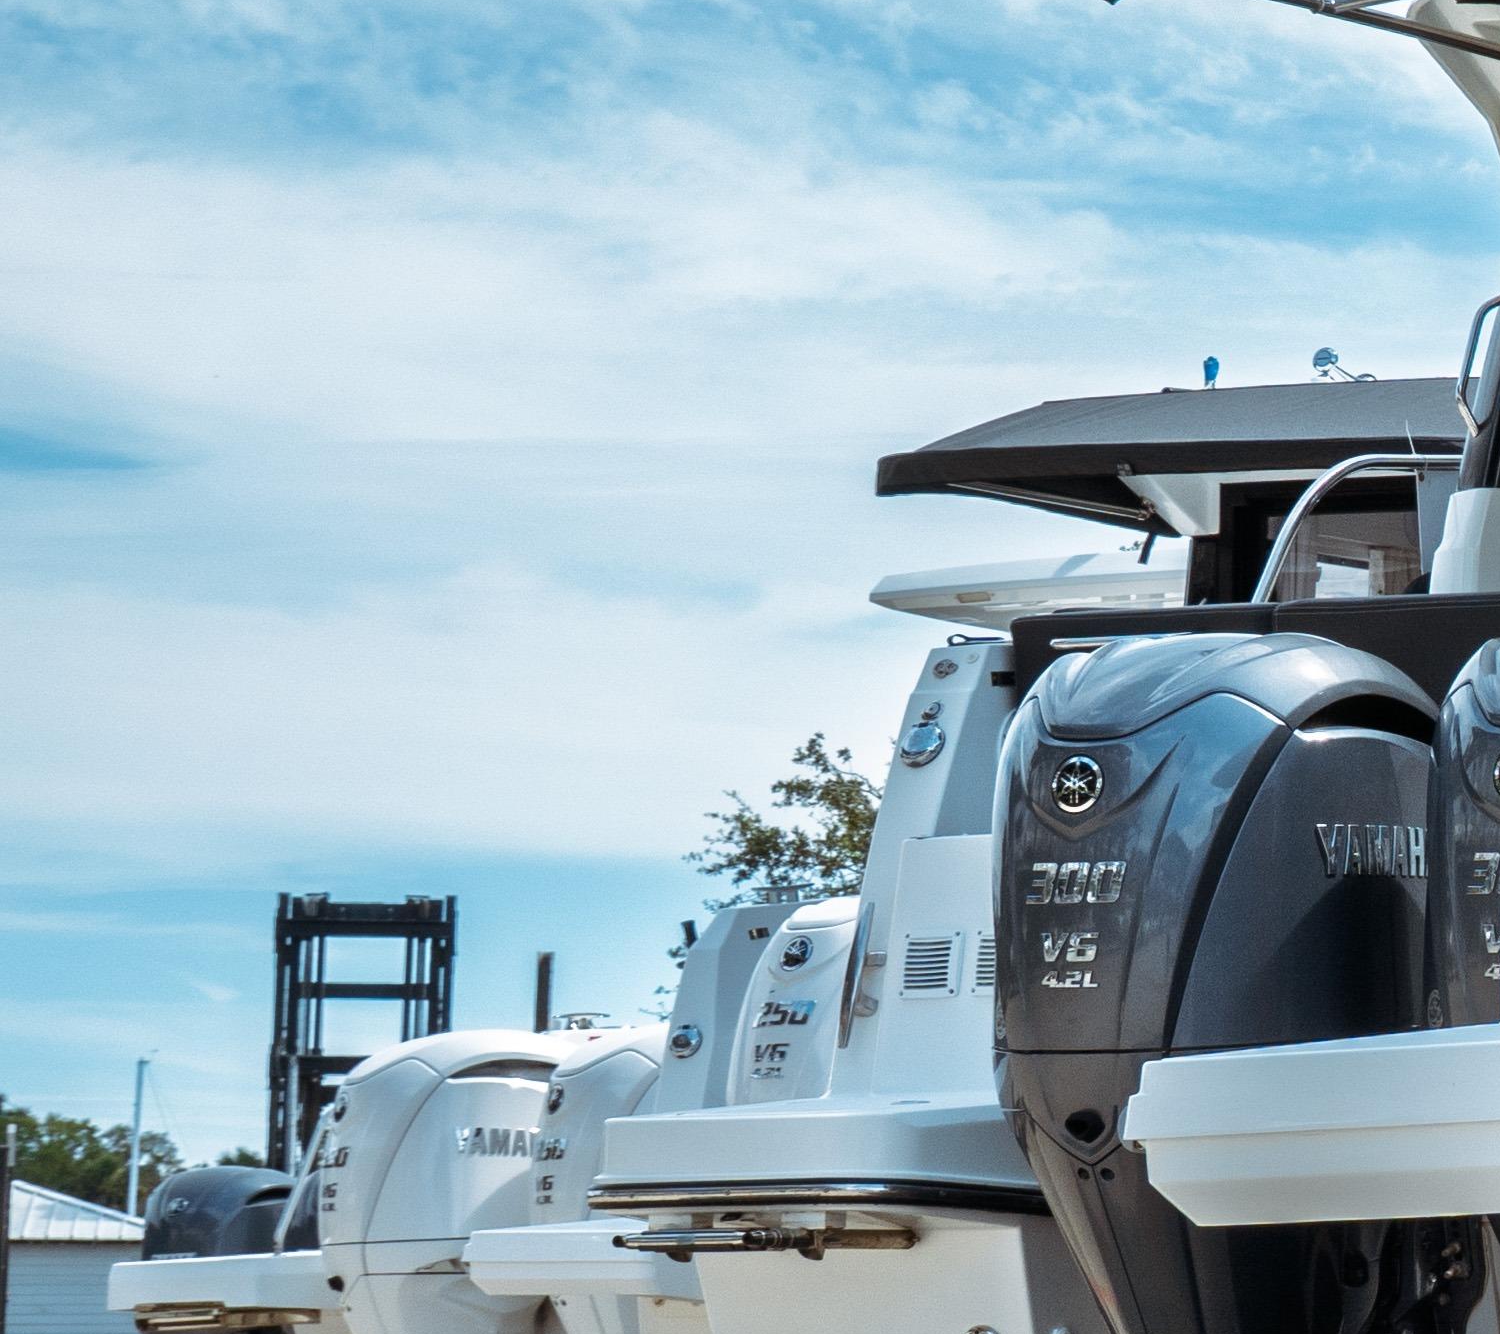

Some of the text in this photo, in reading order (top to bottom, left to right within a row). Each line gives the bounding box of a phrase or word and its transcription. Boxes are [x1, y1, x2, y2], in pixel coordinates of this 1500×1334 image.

[1315, 823, 1428, 878] YAMAH
[1025, 861, 1127, 905] 300
[1041, 931, 1099, 963] V6
[1041, 970, 1098, 988] 4.2L
